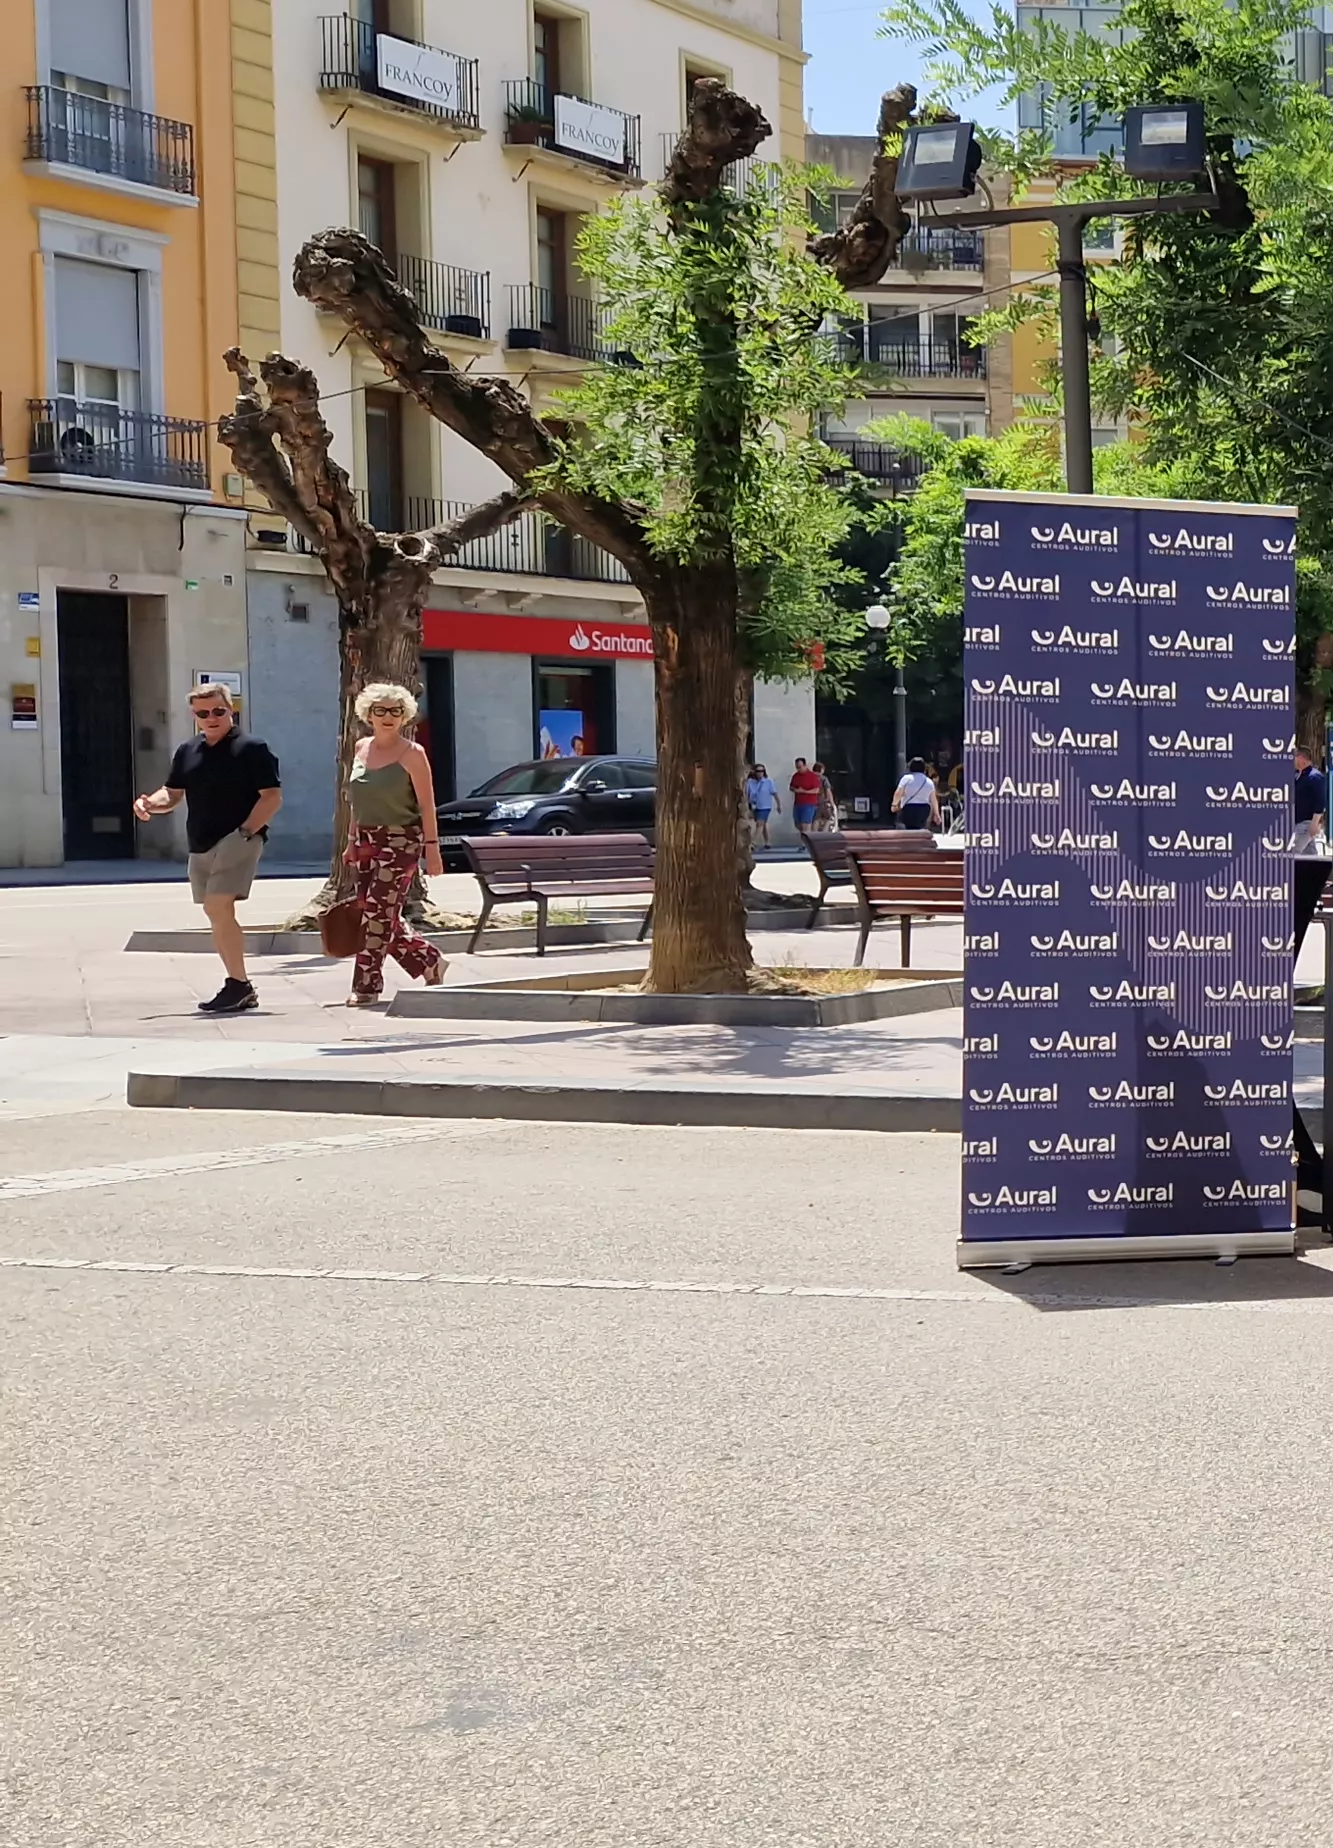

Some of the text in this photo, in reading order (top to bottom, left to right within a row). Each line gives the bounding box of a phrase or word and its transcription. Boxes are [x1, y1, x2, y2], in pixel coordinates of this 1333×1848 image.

[1057, 522, 1118, 545] Aural
[1174, 529, 1233, 551] Aural
[1030, 543, 1118, 553] CENTROS AUDITIVOS
[1149, 548, 1233, 559] CENTROS AUDITIVOS
[109, 574, 119, 590] 2
[998, 570, 1060, 593] Aural
[1117, 576, 1176, 598] Aural
[1013, 593, 1060, 601] AUDITIVOS
[1092, 596, 1176, 606] CENTROS AUDITIVOS
[1231, 582, 1289, 604] Aural
[1206, 601, 1289, 611] CENTROS AUDITIVOS
[1057, 625, 1118, 647] Aural
[1174, 630, 1233, 652] Aural
[1030, 645, 1069, 653] CENTROS
[998, 674, 1060, 697] Aural
[1117, 678, 1176, 700] Aural
[1231, 682, 1289, 703] Aural
[1092, 698, 1129, 706] CENTROS
[1057, 727, 1118, 748] Aural
[1174, 730, 1233, 751] Aural
[998, 776, 1060, 797] Aural
[1116, 779, 1176, 800] Aural
[1231, 781, 1289, 802] Aural
[1057, 828, 1118, 849] Aural
[1174, 830, 1232, 850] Aural
[998, 878, 1059, 899] Aural
[1116, 879, 1176, 900] Aural
[1230, 880, 1289, 901] Aural
[1057, 929, 1117, 950] Aural
[1173, 930, 1232, 950] Aural
[997, 981, 1059, 1001] Aural
[1115, 980, 1175, 1000] Aural
[1230, 980, 1288, 1000] Aural
[1056, 1030, 1117, 1051] Aural
[1173, 1029, 1231, 1049] Aural
[996, 1082, 1058, 1103] Aural
[1115, 1080, 1174, 1100] Aural
[1229, 1079, 1287, 1099] Aural
[1055, 1133, 1116, 1153] Aural
[1172, 1131, 1230, 1150] Aural
[995, 1185, 1057, 1206] Aural
[1114, 1182, 1173, 1202] Aural
[1229, 1180, 1286, 1199] Aural
[1010, 1205, 1057, 1213] AUDITIVOS
